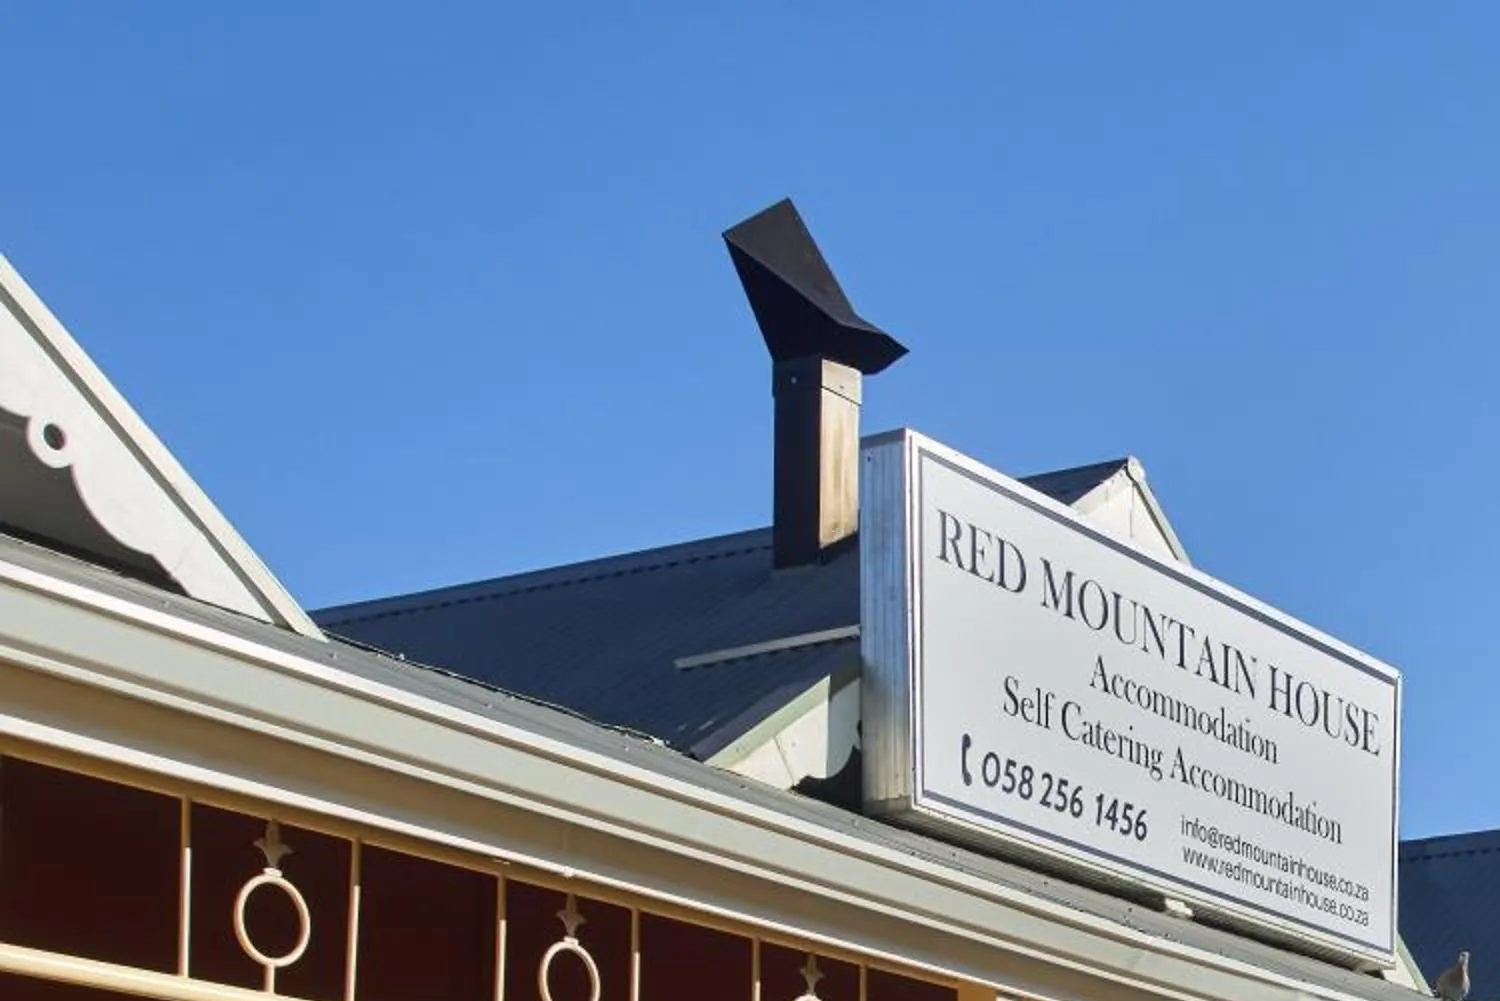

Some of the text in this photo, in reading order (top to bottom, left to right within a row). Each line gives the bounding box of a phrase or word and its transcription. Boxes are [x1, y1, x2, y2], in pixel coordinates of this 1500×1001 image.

[938, 509, 1380, 757] RED MOUNTAIN HOUSE
[1003, 675, 1342, 845] Self Catering Accommodation
[1090, 655, 1279, 765] Accommodation
[982, 751, 1148, 842] 058 256 1456
[1181, 816, 1369, 902] info@redmountainhouse.co.za
[1183, 847, 1369, 927] www.redmountainhouse.co.za
